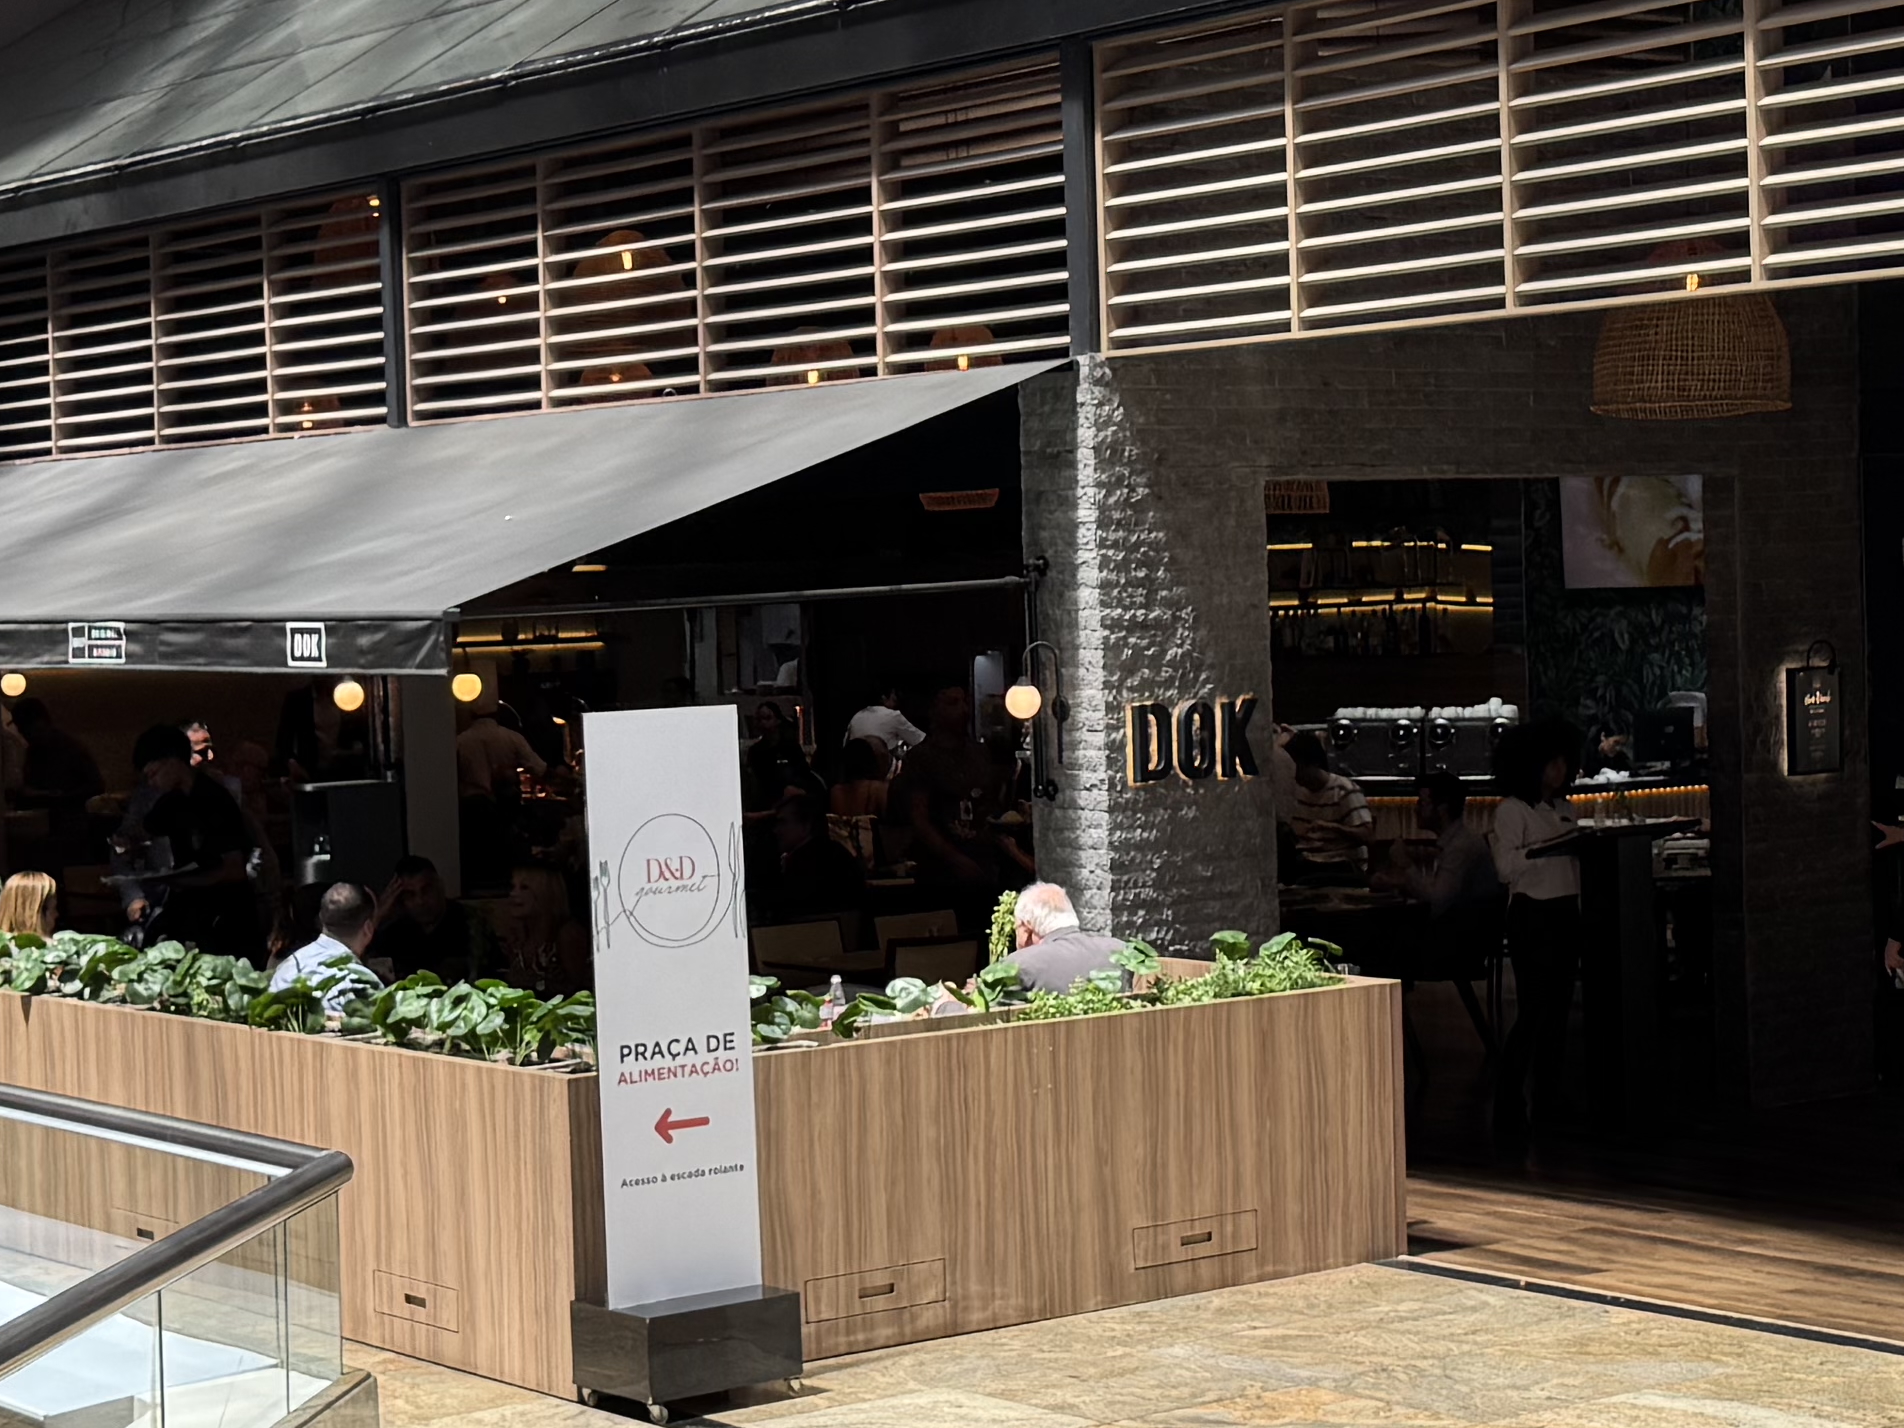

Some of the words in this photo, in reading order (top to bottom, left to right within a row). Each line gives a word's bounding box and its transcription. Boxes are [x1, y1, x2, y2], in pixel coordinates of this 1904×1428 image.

[293, 633, 319, 658] DOK
[1126, 696, 1259, 786] DOK
[646, 855, 695, 884] D&D
[633, 874, 711, 904] gourmet
[619, 1036, 698, 1065] PRAÇA
[705, 1031, 736, 1054] DE
[617, 1056, 740, 1086] ALIMENTAÇÃO!
[620, 1174, 658, 1189] Acesso
[669, 1168, 706, 1182] escada
[707, 1163, 744, 1176] rolante
